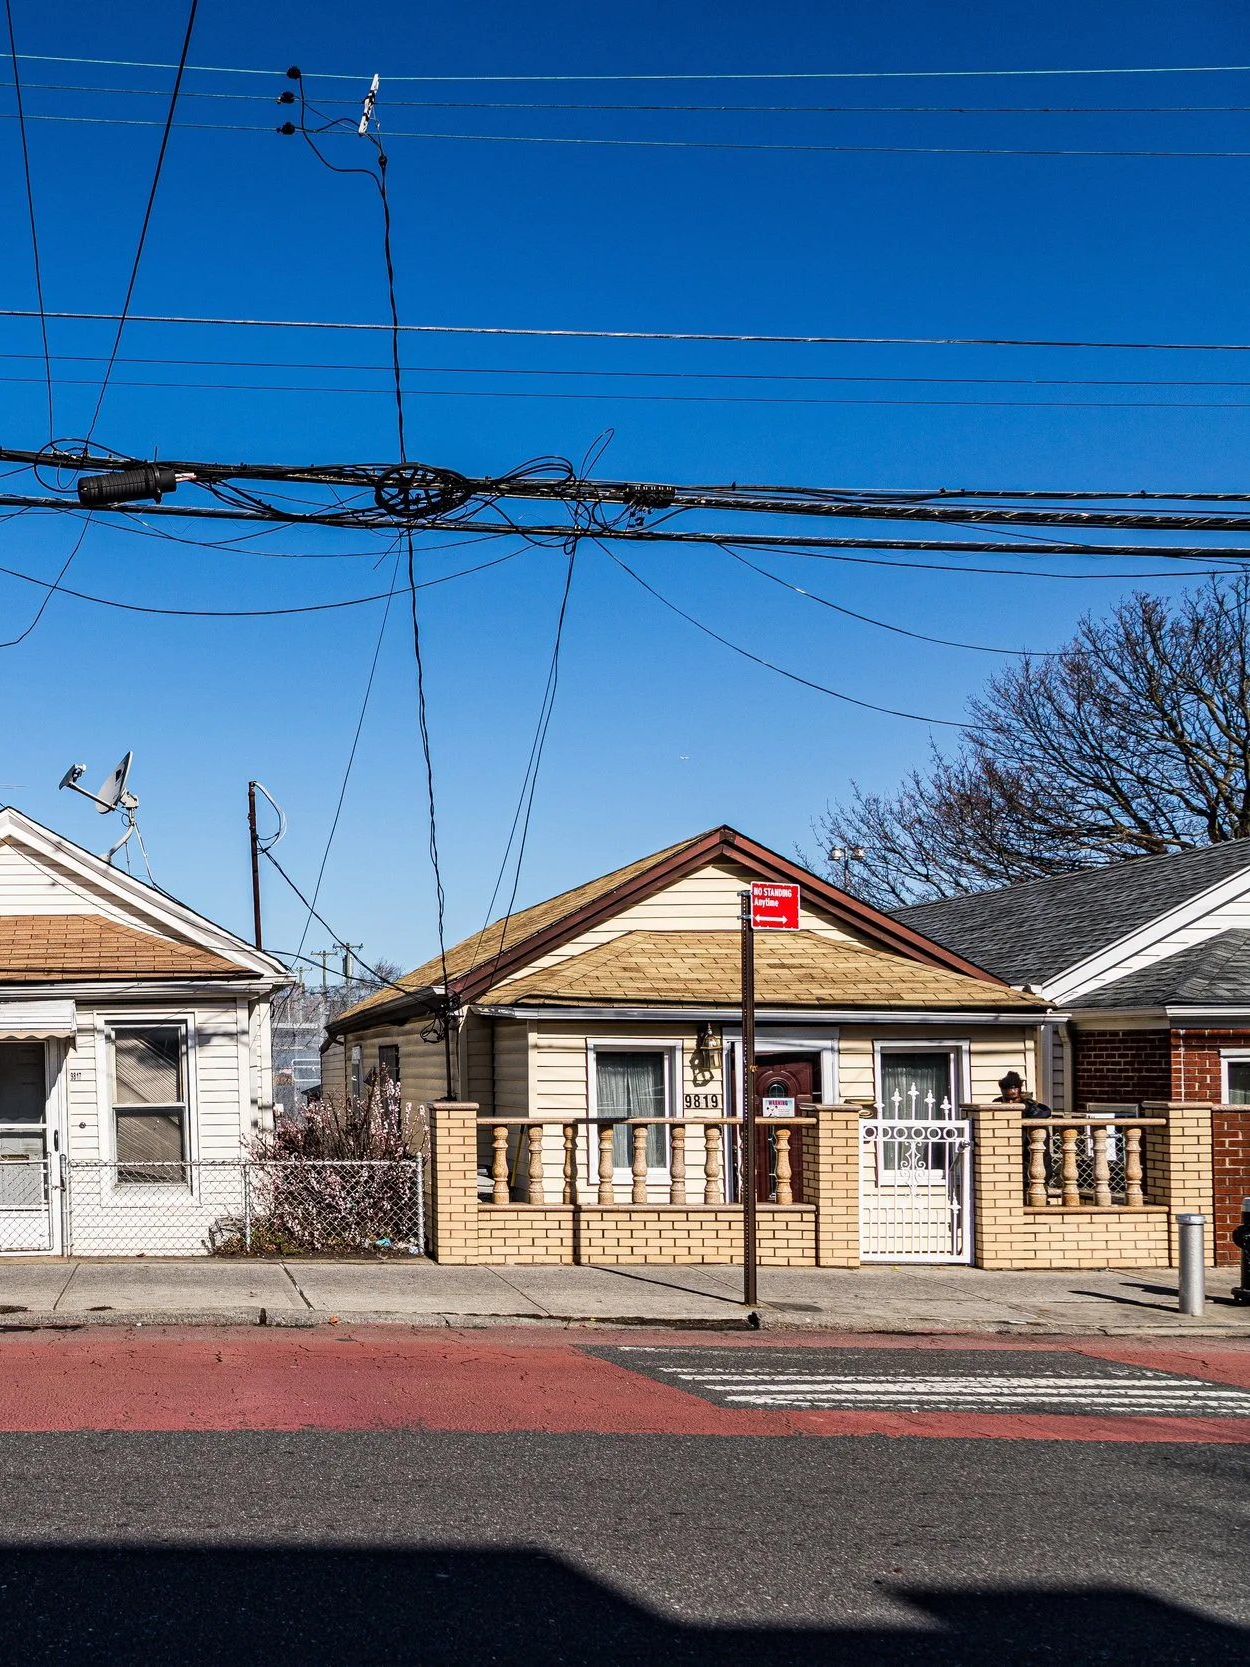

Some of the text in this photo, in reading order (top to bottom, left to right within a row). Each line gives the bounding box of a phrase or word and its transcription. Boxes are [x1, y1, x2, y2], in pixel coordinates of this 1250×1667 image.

[753, 888, 792, 897] NO STANDING
[754, 898, 779, 907] Anytime
[684, 1094, 718, 1108] 9819
